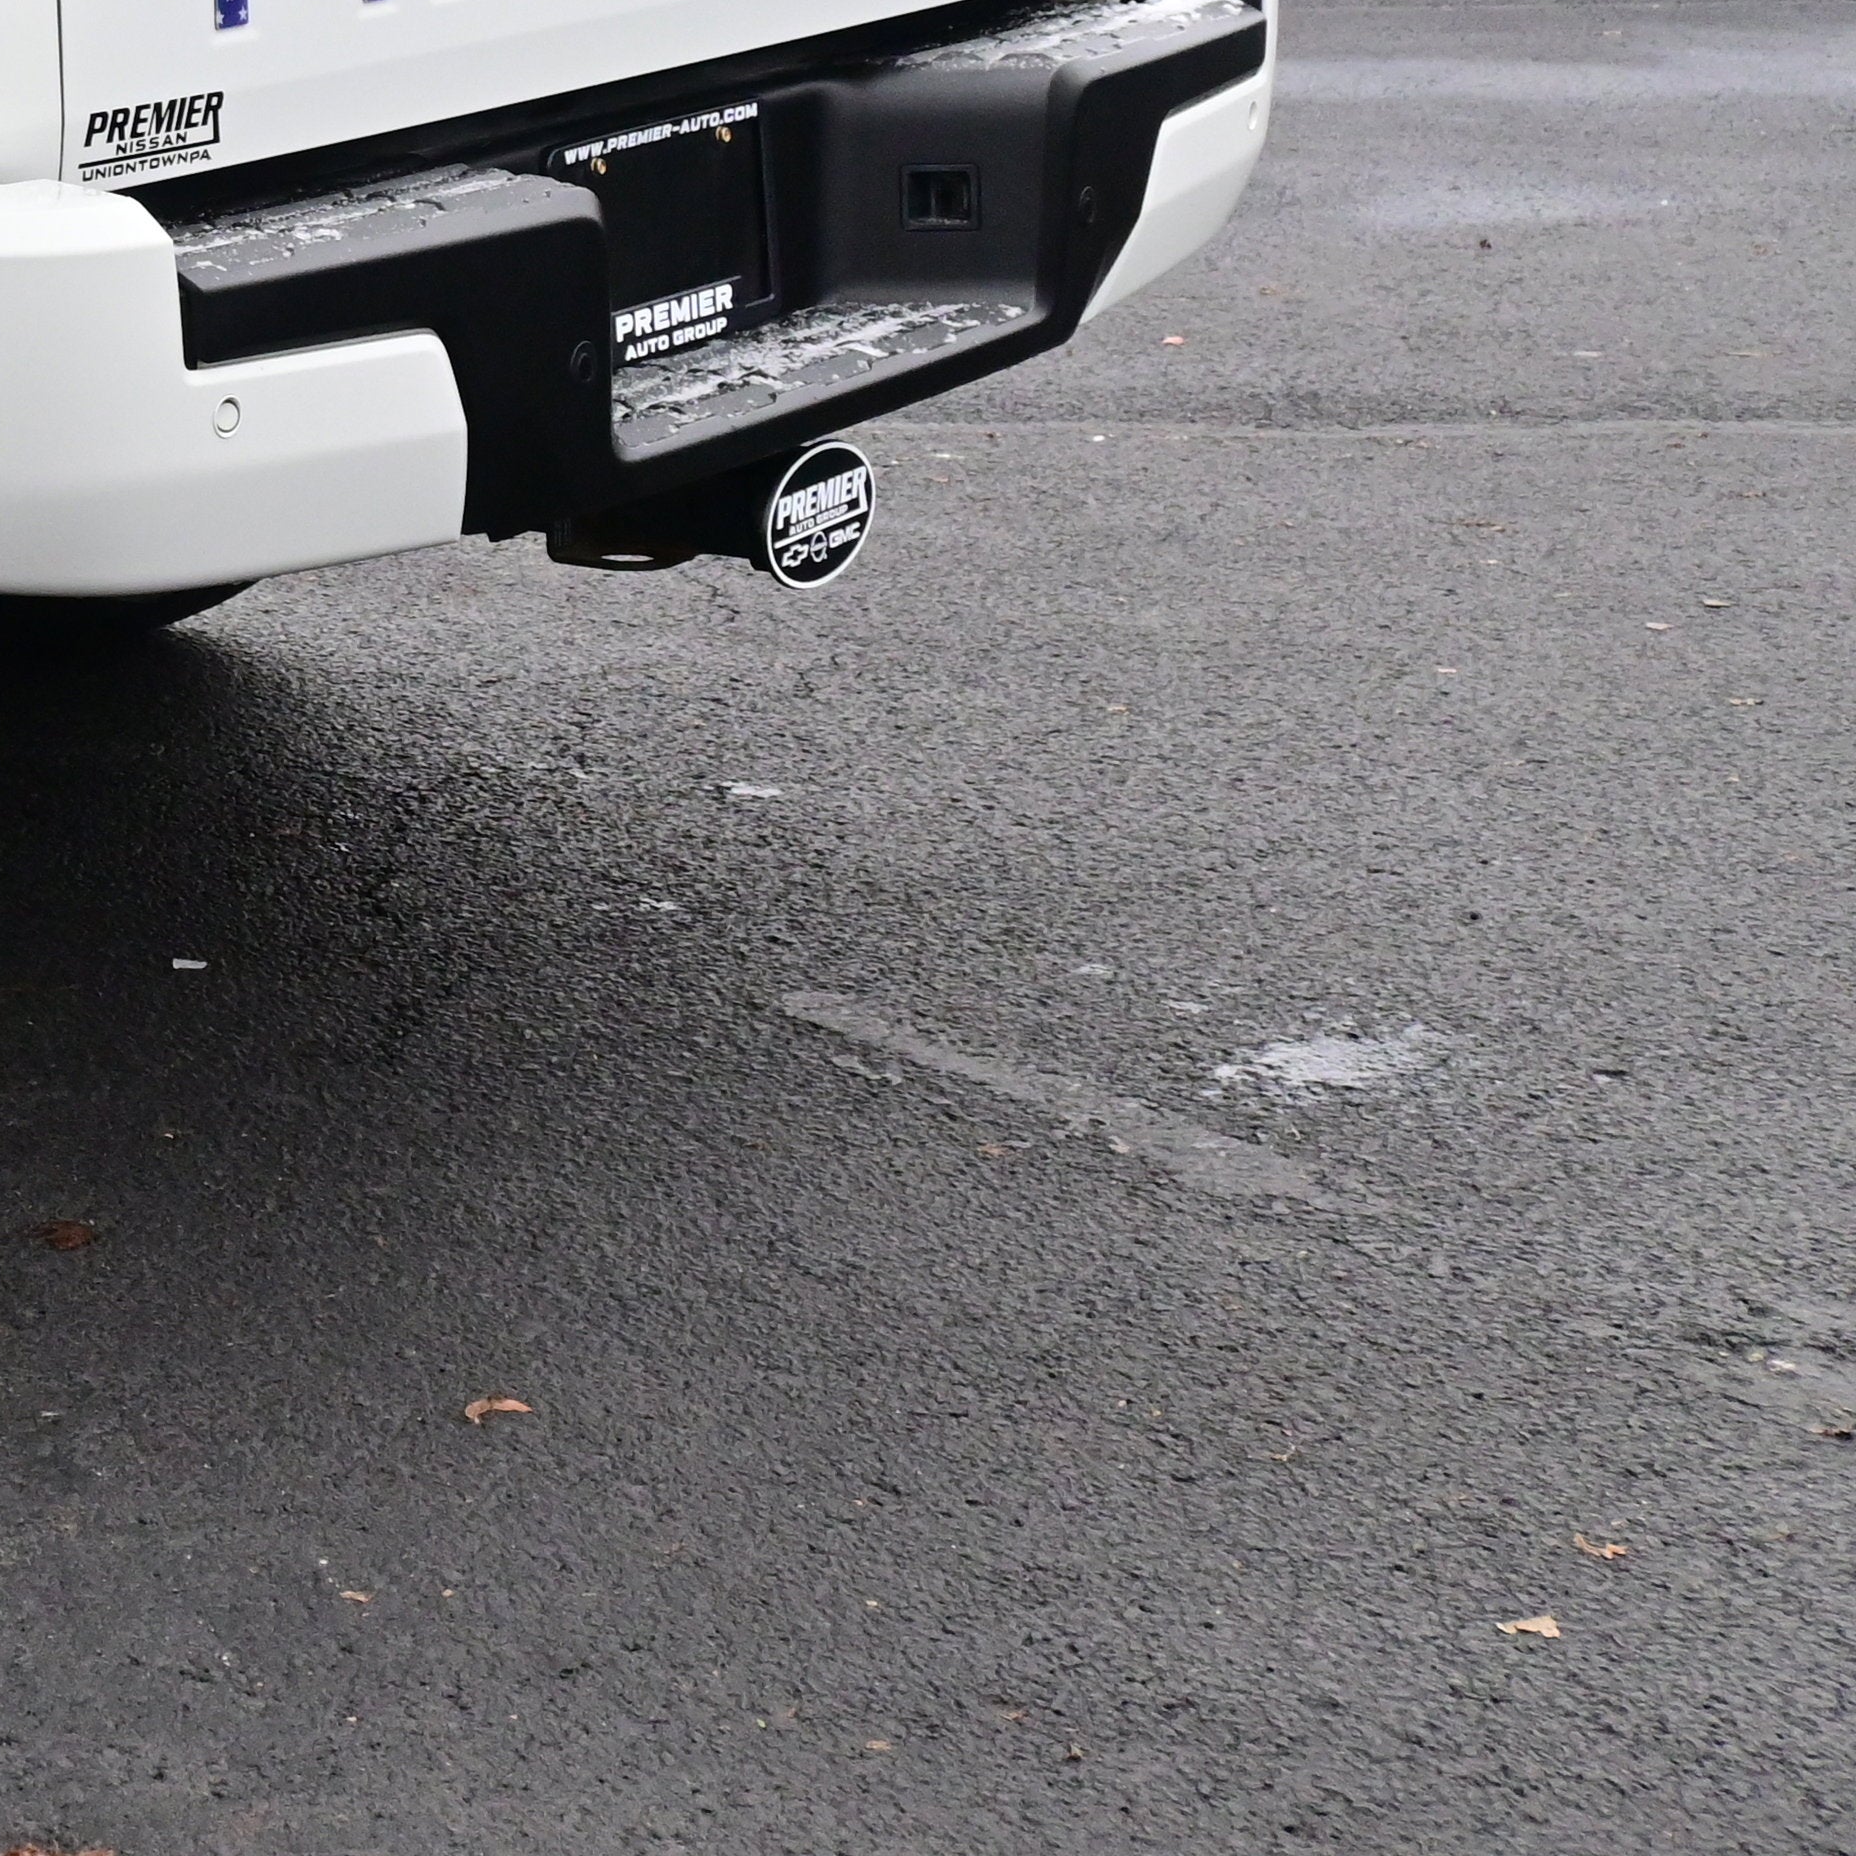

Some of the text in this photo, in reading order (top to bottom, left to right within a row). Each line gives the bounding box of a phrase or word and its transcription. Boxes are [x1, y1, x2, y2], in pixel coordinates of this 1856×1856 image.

[83, 91, 224, 148] PREMIER
[115, 131, 188, 156] NISSAN
[564, 102, 758, 166] WWW.PREMIER-AUTO.COM
[615, 283, 734, 343] PREMIER
[624, 317, 728, 361] AUTO GROUP
[776, 465, 868, 530] PREMIER
[789, 504, 848, 536] AUTO GROUP
[829, 521, 861, 549] GMC
